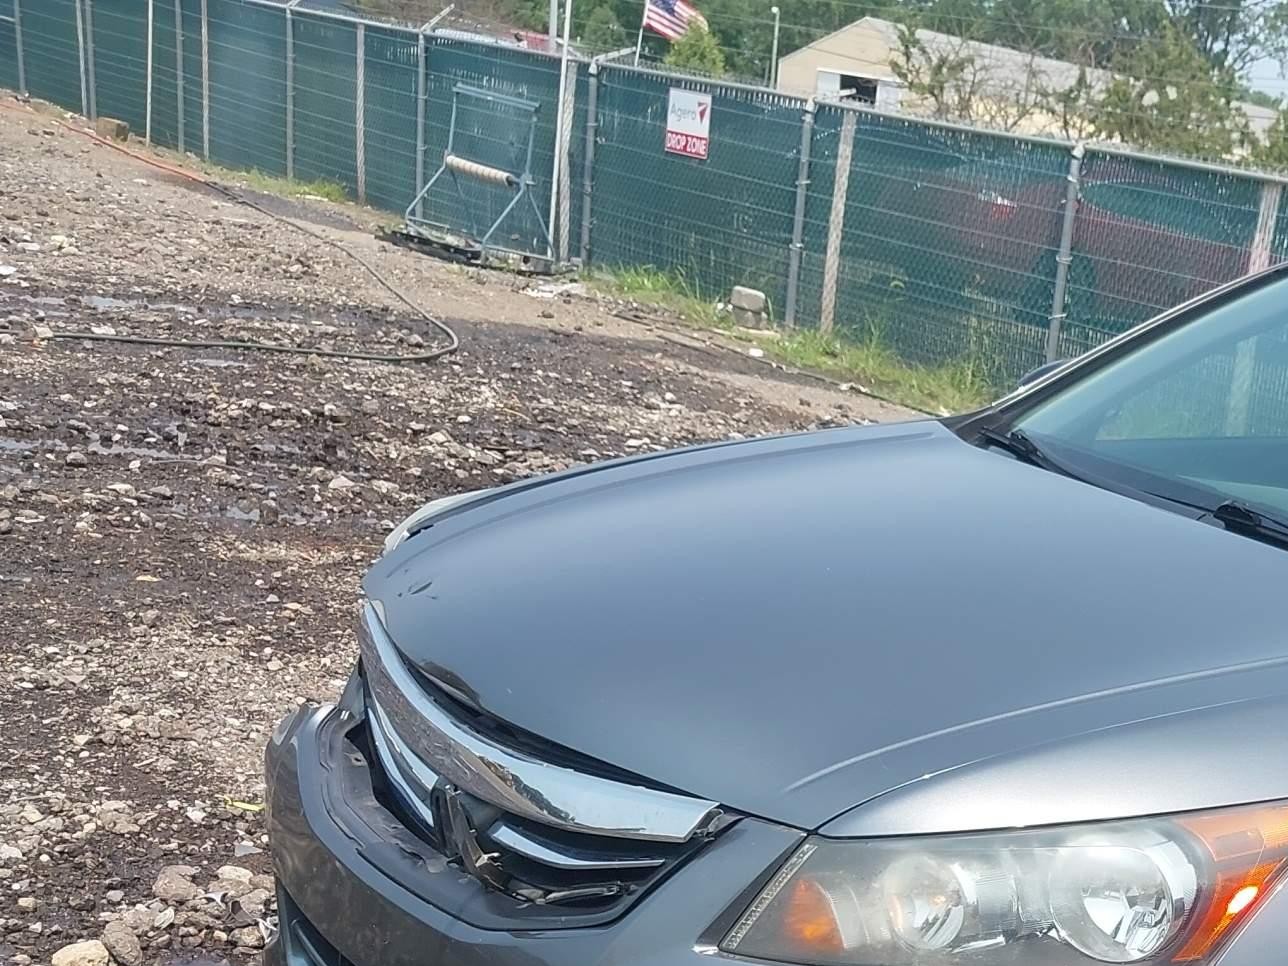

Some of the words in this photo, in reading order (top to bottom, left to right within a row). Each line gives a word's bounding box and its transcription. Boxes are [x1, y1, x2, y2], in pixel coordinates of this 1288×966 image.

[671, 103, 696, 121] Agero
[667, 133, 686, 150] DROP
[686, 137, 706, 155] ZONE
